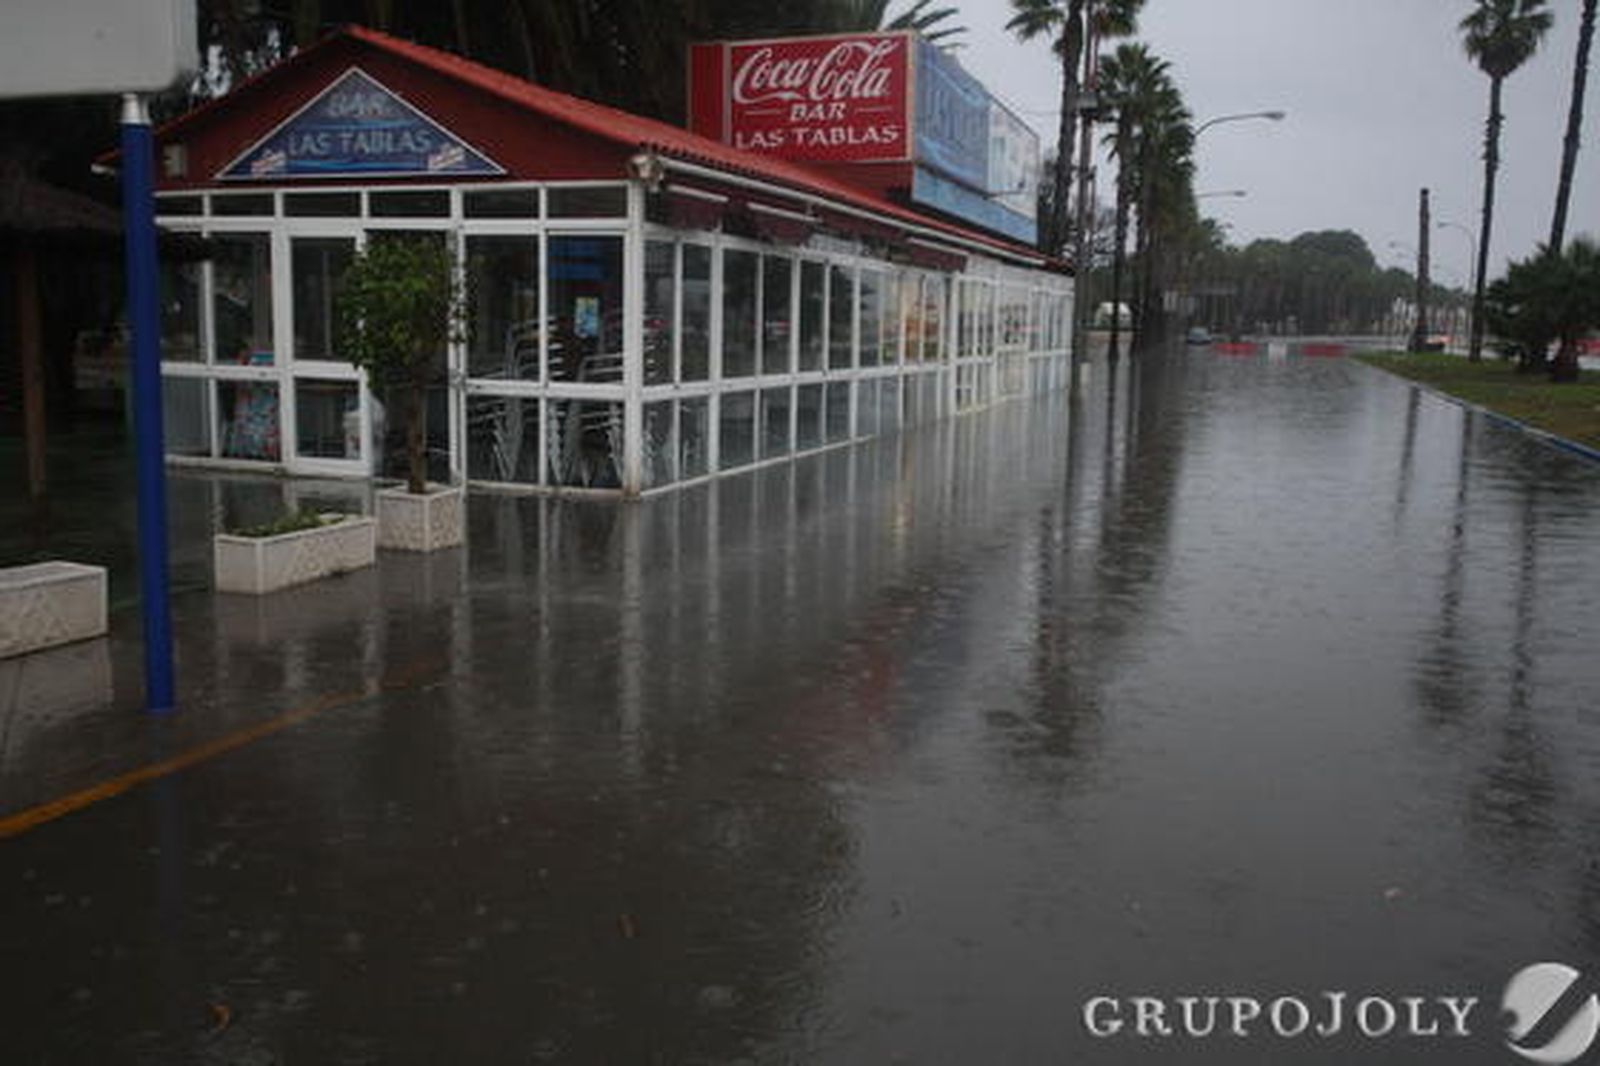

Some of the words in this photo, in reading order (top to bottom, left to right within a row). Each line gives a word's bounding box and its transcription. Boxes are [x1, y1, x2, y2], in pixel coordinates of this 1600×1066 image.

[790, 101, 846, 122] BAR
[288, 133, 332, 156] LAS
[338, 128, 431, 154] TABLAS
[737, 131, 784, 149] LAS
[792, 124, 899, 146] TABLAS
